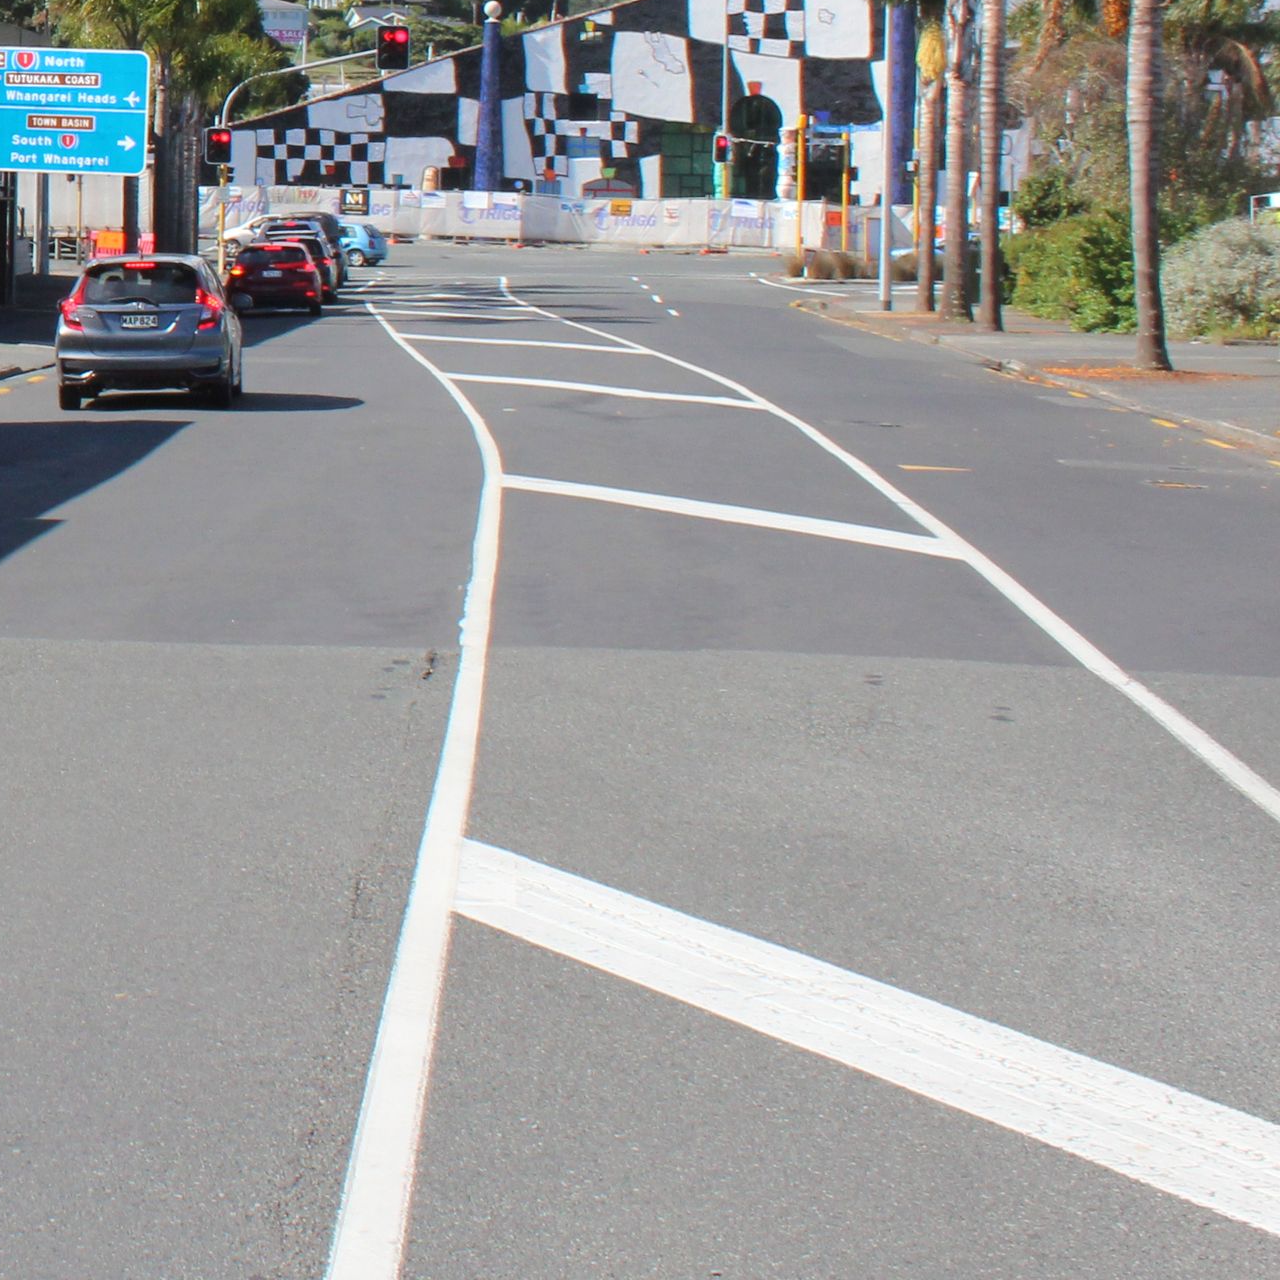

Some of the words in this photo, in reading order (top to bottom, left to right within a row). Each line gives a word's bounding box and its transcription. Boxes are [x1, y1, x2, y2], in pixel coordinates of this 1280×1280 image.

[44, 56, 85, 68] North
[8, 74, 60, 84] TUTUKAKA
[65, 76, 96, 85] COAST
[6, 90, 71, 104] Whangarei
[78, 93, 117, 104] Heads
[32, 117, 57, 127] TOWN
[61, 119, 89, 128] BASIN
[12, 135, 52, 147] South
[11, 152, 37, 164] Port
[43, 153, 109, 169] Whangarei
[478, 208, 523, 221] TRIGG
